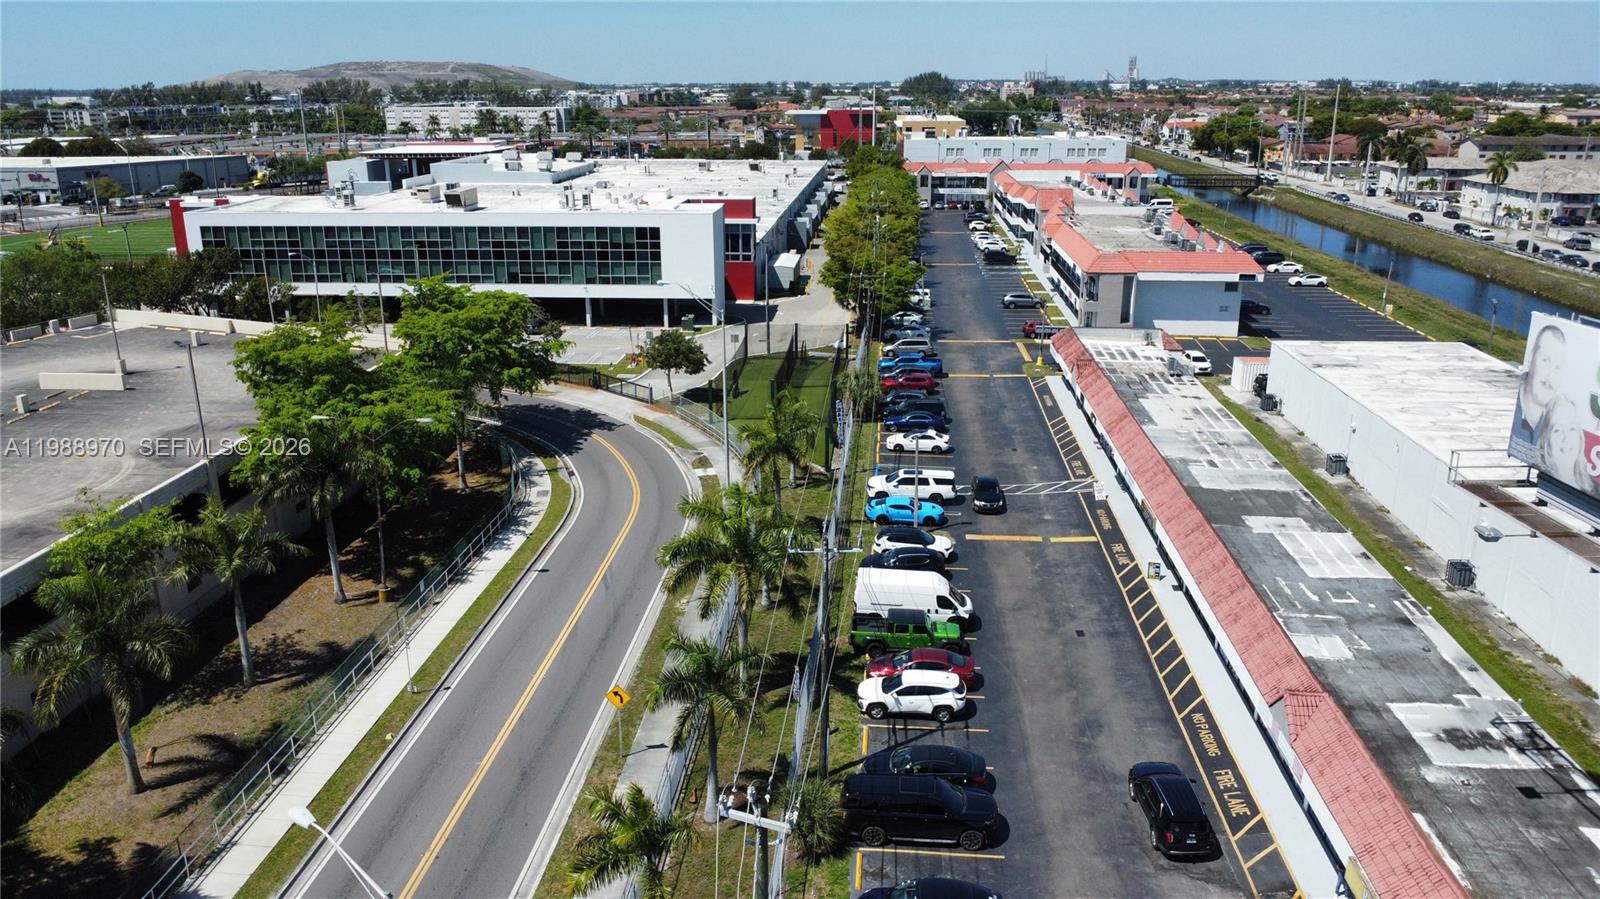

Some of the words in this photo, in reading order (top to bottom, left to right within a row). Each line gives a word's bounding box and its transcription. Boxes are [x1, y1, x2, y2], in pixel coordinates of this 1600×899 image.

[1191, 713, 1204, 727] NO
[1198, 725, 1221, 757] PARKING
[1213, 769, 1238, 790] FIRE
[1223, 791, 1251, 817] LANE
